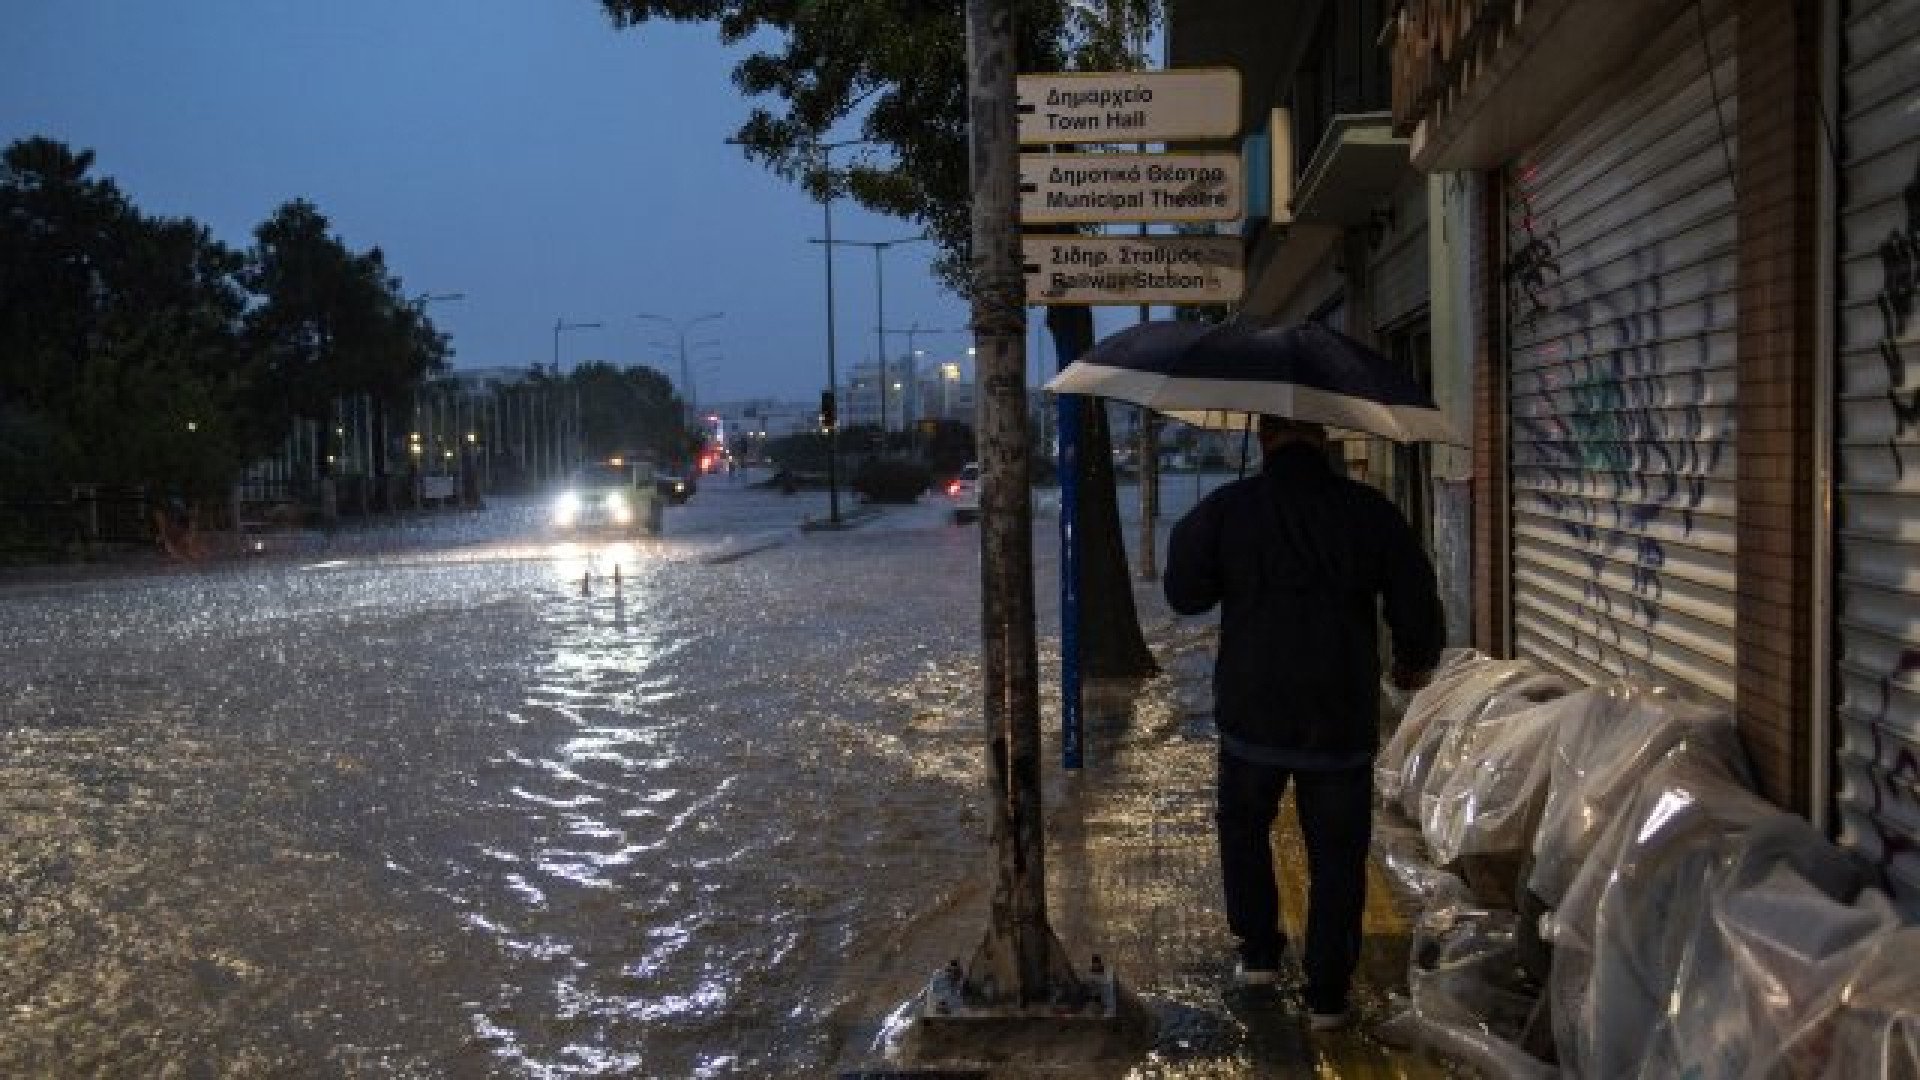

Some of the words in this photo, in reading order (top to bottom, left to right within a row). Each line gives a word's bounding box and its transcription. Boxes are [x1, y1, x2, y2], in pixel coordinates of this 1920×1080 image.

[1047, 84, 1153, 108] Δημαρχείο
[1047, 113, 1099, 129] Town
[1106, 111, 1147, 129] Hall
[1049, 165, 1141, 186] Δημοτικό
[1047, 191, 1144, 210] Municipal
[1151, 191, 1228, 207] Theatre
[1135, 272, 1203, 289] Station
